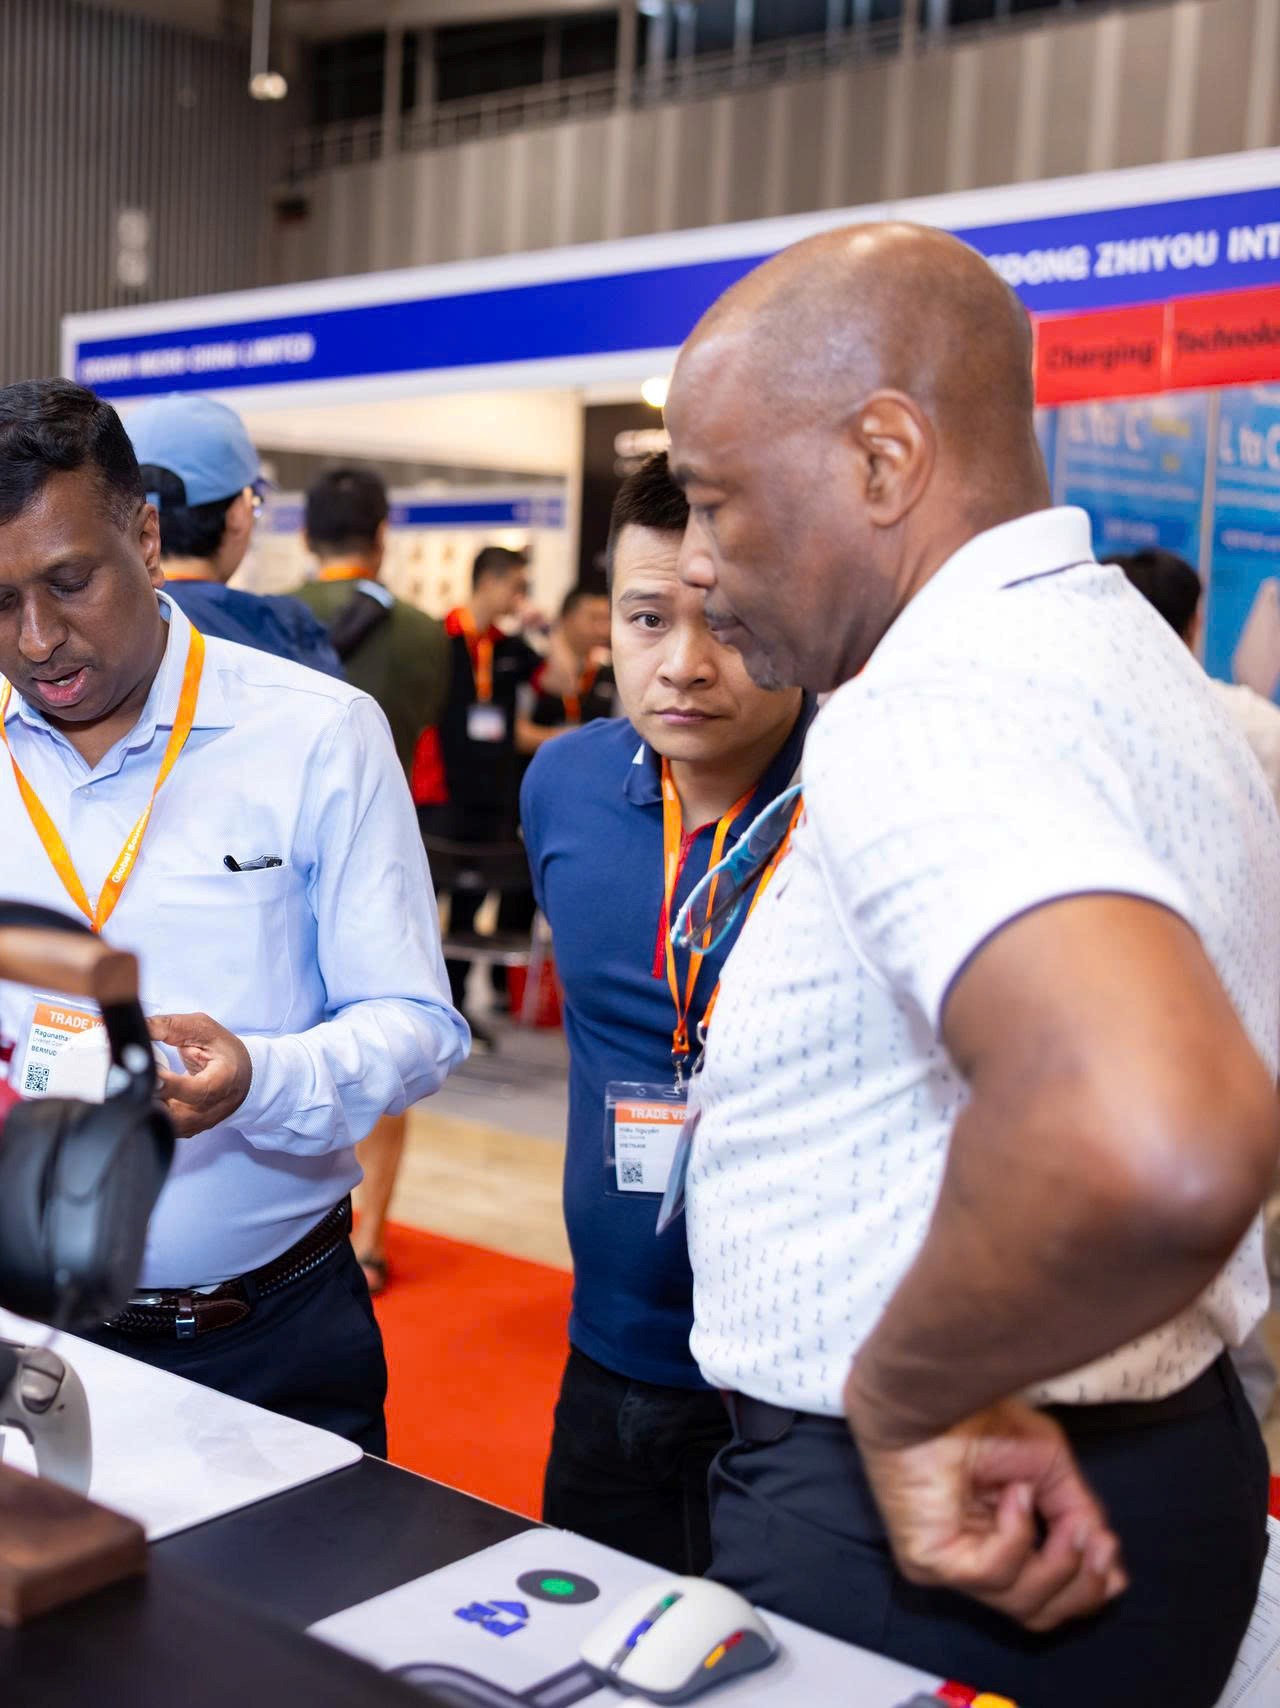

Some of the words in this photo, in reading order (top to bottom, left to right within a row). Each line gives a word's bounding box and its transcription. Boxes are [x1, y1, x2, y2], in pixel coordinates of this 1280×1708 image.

[1094, 229, 1219, 279] ZHIYOU
[1045, 340, 1155, 372] Charging
[111, 852, 132, 883] Global
[49, 1010, 89, 1031] TRADE
[631, 1108, 669, 1120] TRADE
